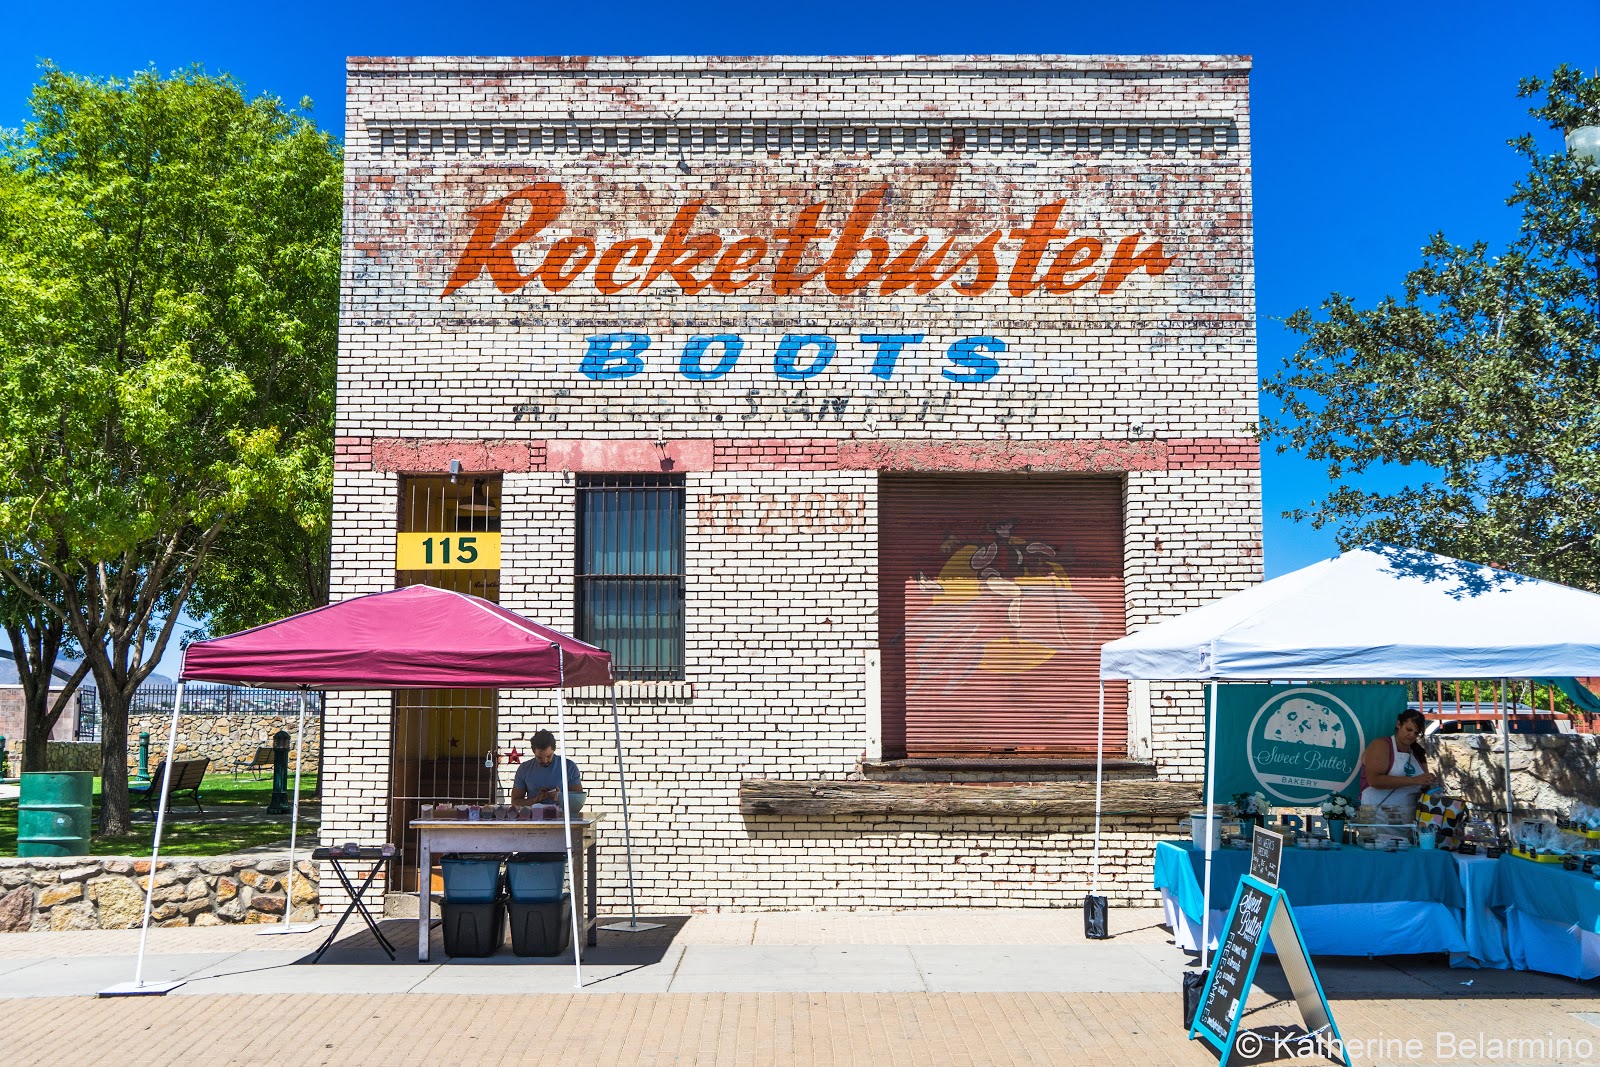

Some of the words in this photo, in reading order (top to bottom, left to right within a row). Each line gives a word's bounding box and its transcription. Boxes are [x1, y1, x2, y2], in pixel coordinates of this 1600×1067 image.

[440, 181, 1177, 299] Rocketbuster
[577, 332, 1007, 383] BOOTS
[422, 537, 478, 564] 115
[1254, 745, 1300, 766] Sweet
[1303, 750, 1352, 774] Butter
[1281, 776, 1319, 787] BAKERY
